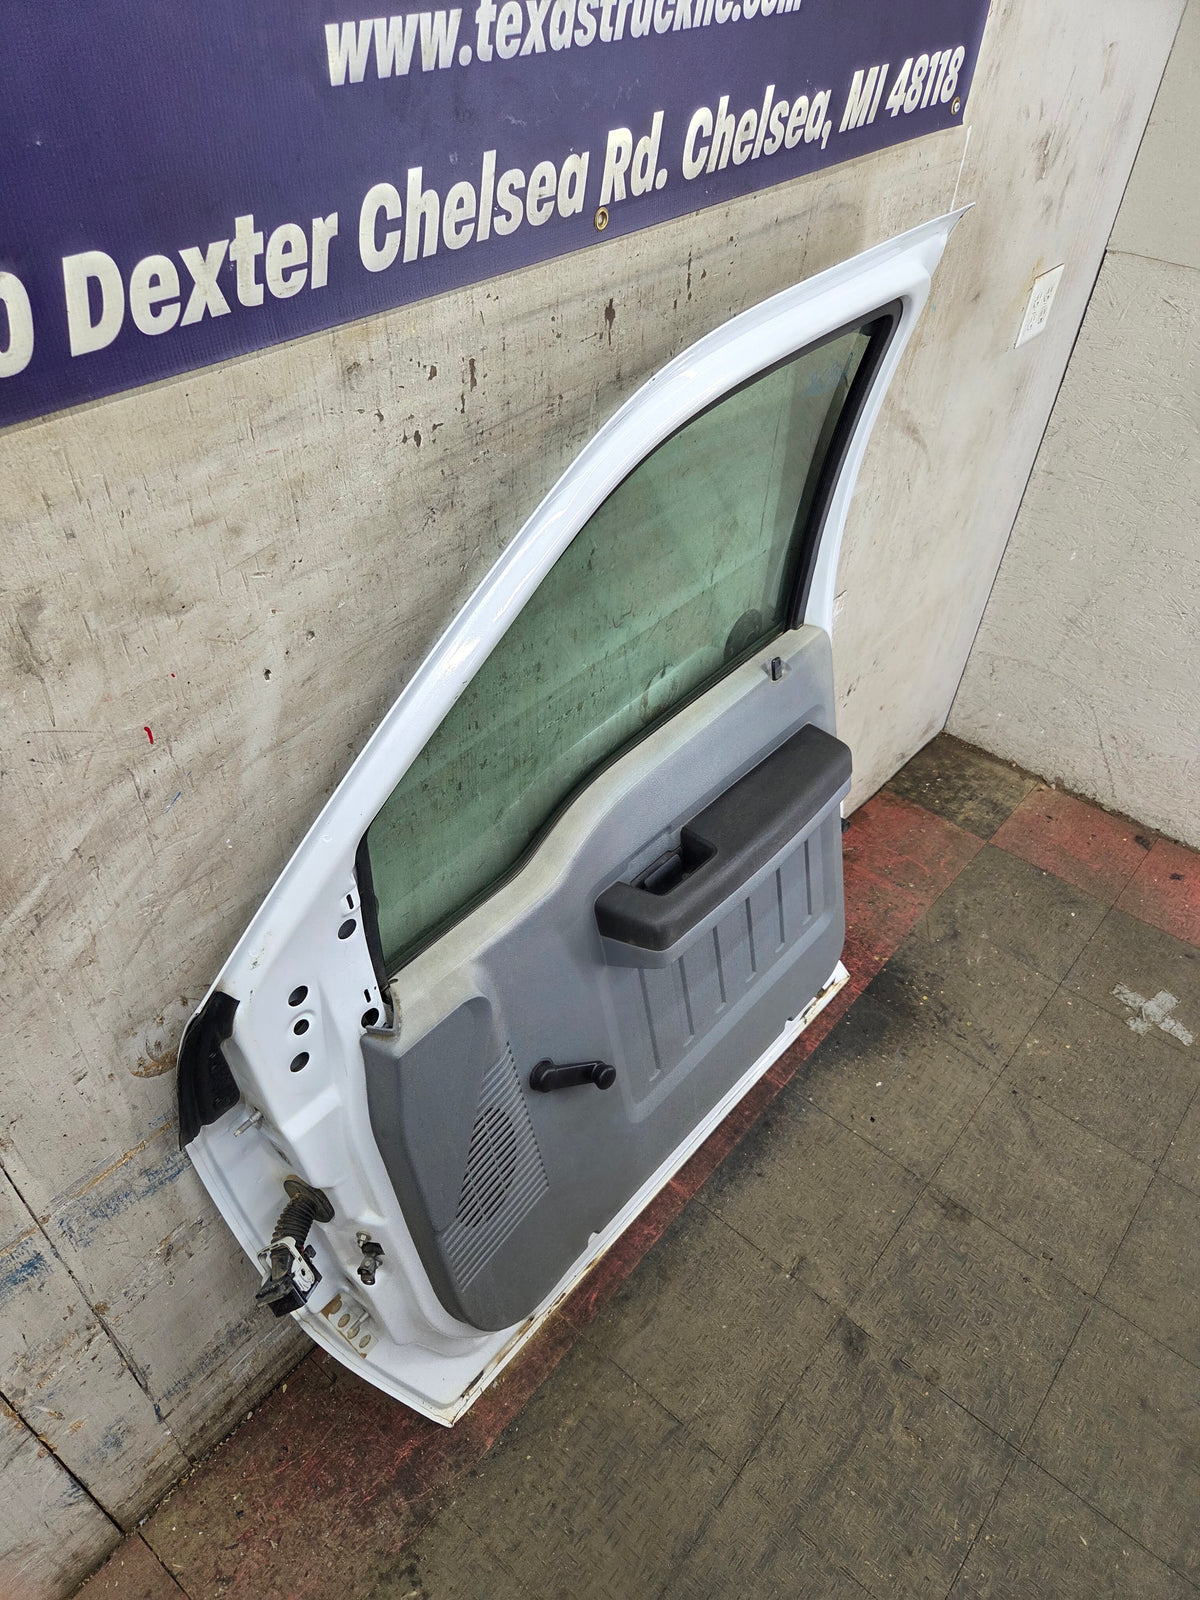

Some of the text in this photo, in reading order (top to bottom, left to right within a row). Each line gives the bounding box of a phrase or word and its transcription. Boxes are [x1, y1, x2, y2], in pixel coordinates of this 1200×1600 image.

[62, 212, 339, 358] Dexter
[358, 150, 590, 273] Chelsea
[599, 109, 668, 207] Rd.
[682, 83, 832, 181] Chelsea,
[838, 63, 890, 133] MI
[885, 45, 966, 118] 48118
